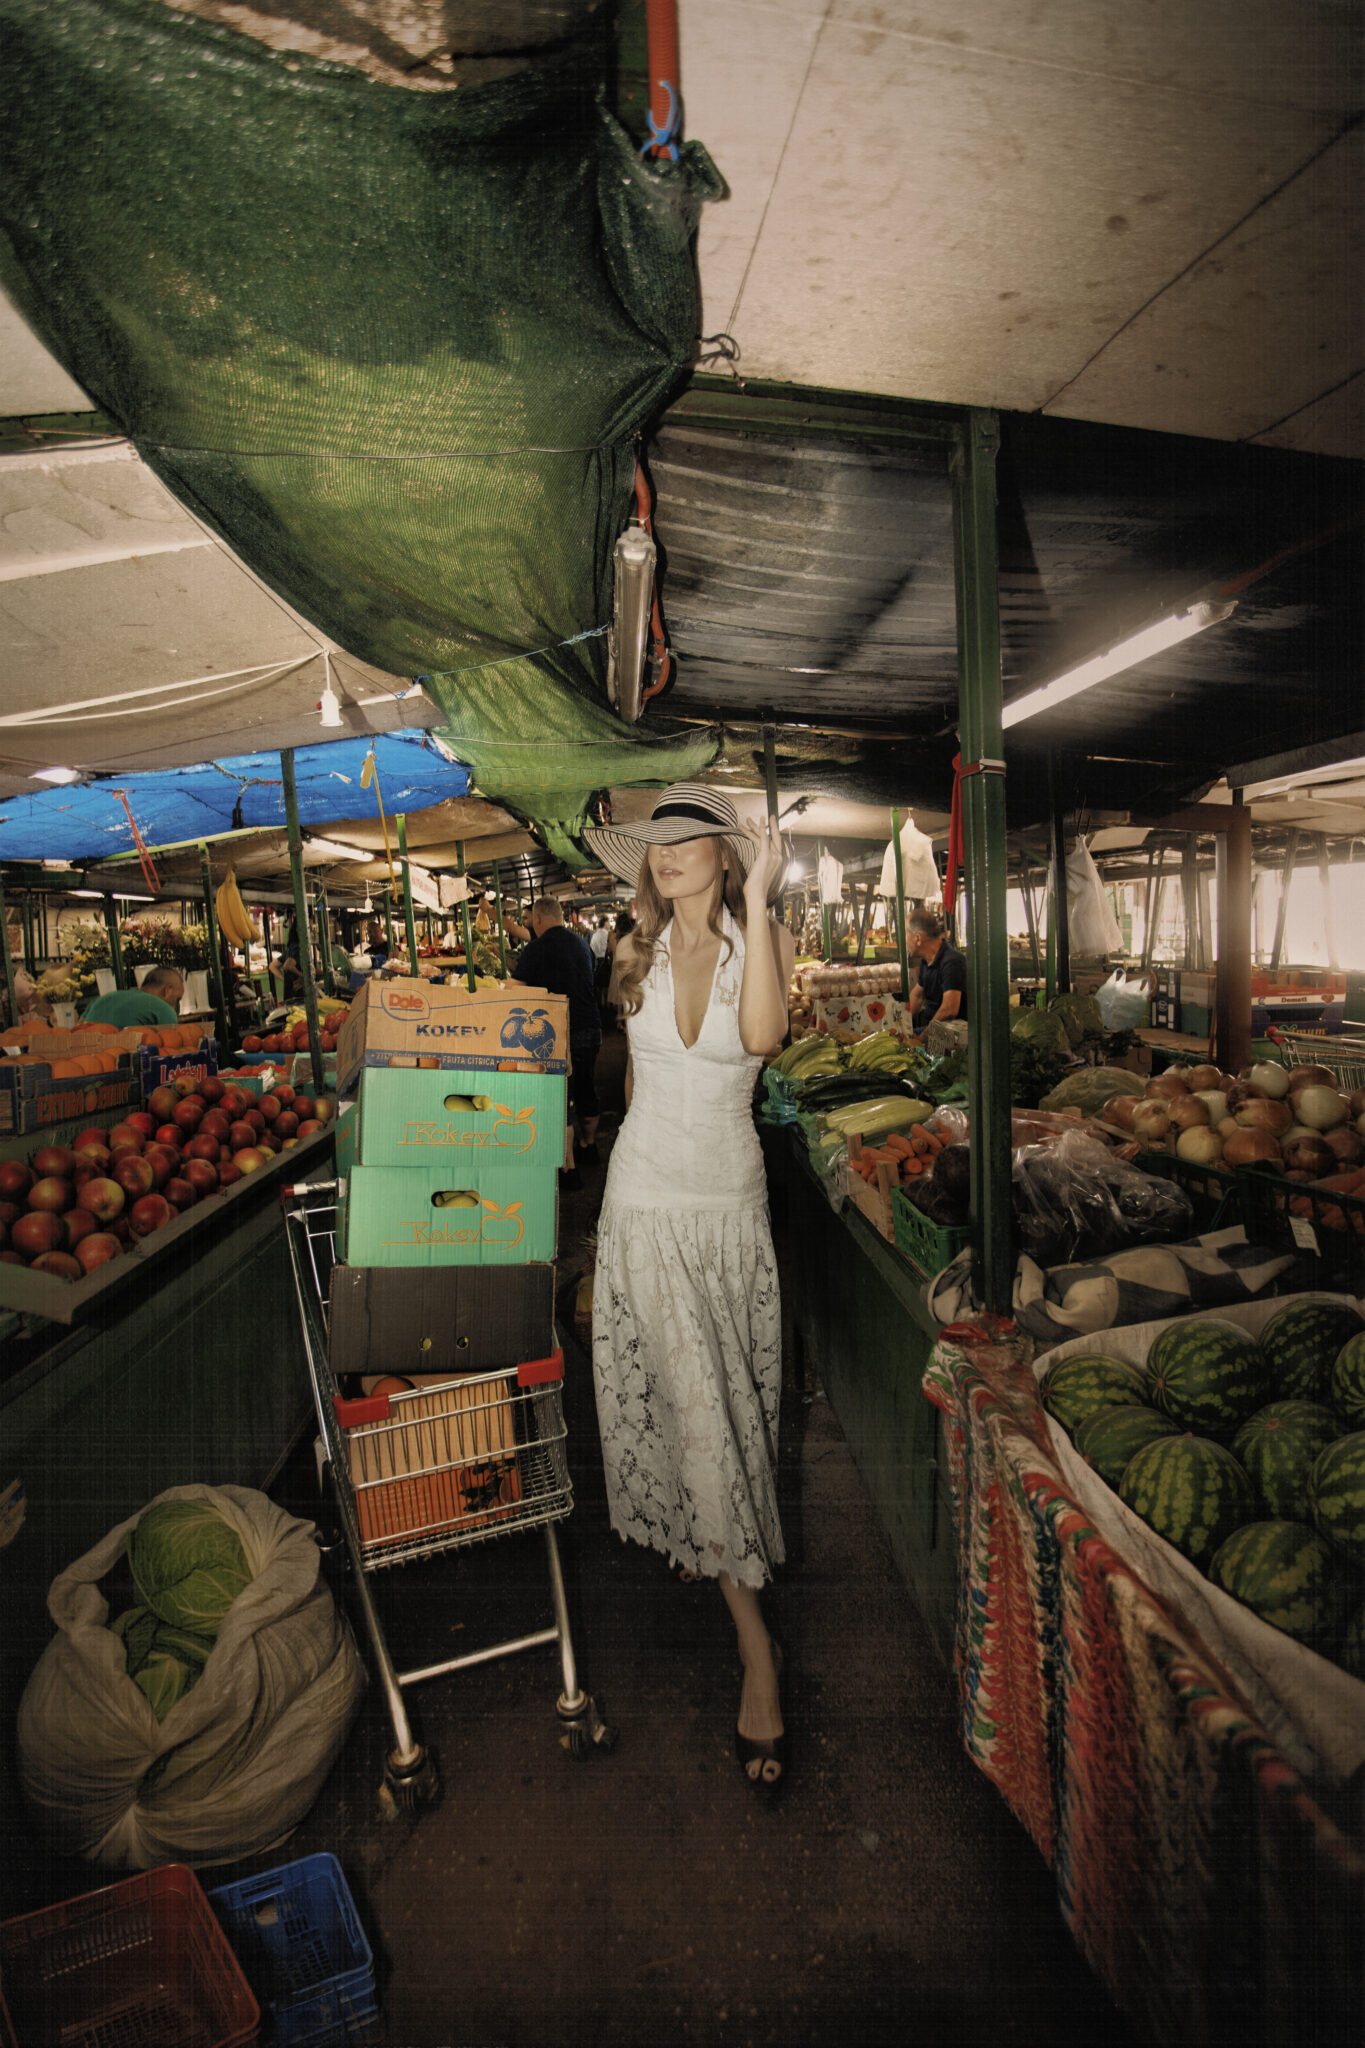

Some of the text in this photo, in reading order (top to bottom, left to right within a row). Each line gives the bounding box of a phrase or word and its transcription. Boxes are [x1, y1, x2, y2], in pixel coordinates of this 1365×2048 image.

[388, 993, 424, 1009] Dole
[442, 1055, 466, 1066] FRUTA
[467, 1056, 495, 1066] CÍTRICA
[37, 1090, 84, 1123] EXTRA
[414, 1121, 491, 1145] Kokev
[412, 1221, 481, 1242] Kokev
